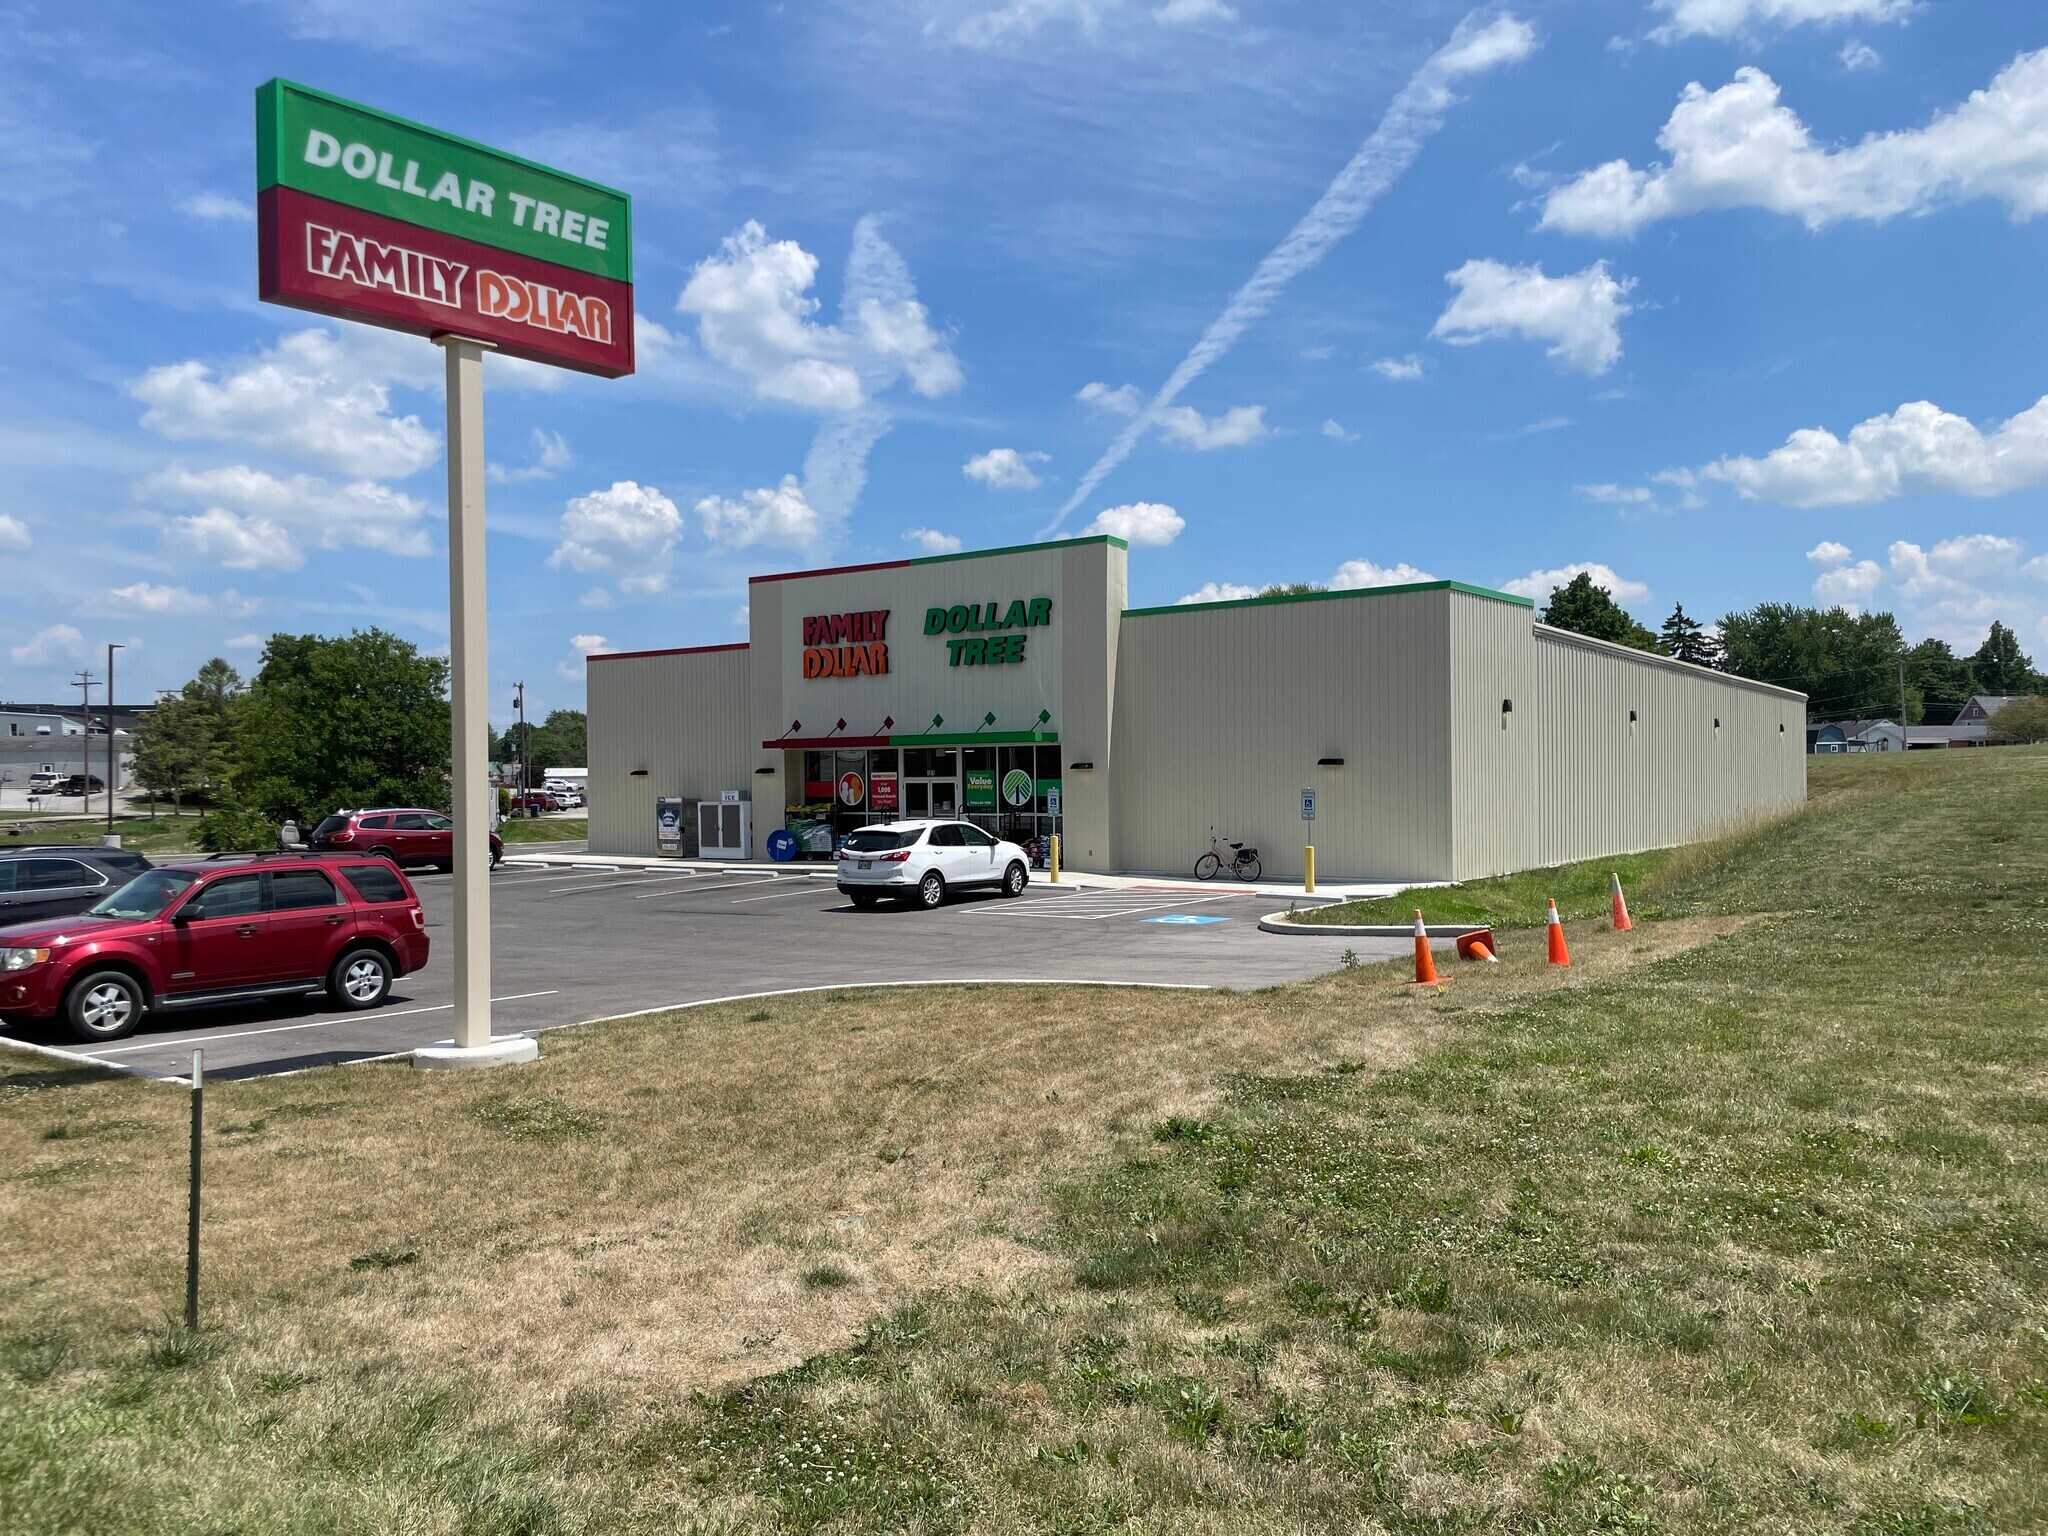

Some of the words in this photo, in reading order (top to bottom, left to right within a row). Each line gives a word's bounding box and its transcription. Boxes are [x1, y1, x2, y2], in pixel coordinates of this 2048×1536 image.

[304, 129, 496, 218] DOLLAR
[509, 192, 611, 251] TREE
[305, 221, 470, 309] FAMILY
[476, 269, 613, 345] DOLLAR
[803, 609, 890, 646] FAMILY
[923, 597, 1052, 636] DOLLAR
[803, 642, 890, 679] DOLLAR
[946, 634, 1028, 667] TREE
[969, 776, 992, 785] Value
